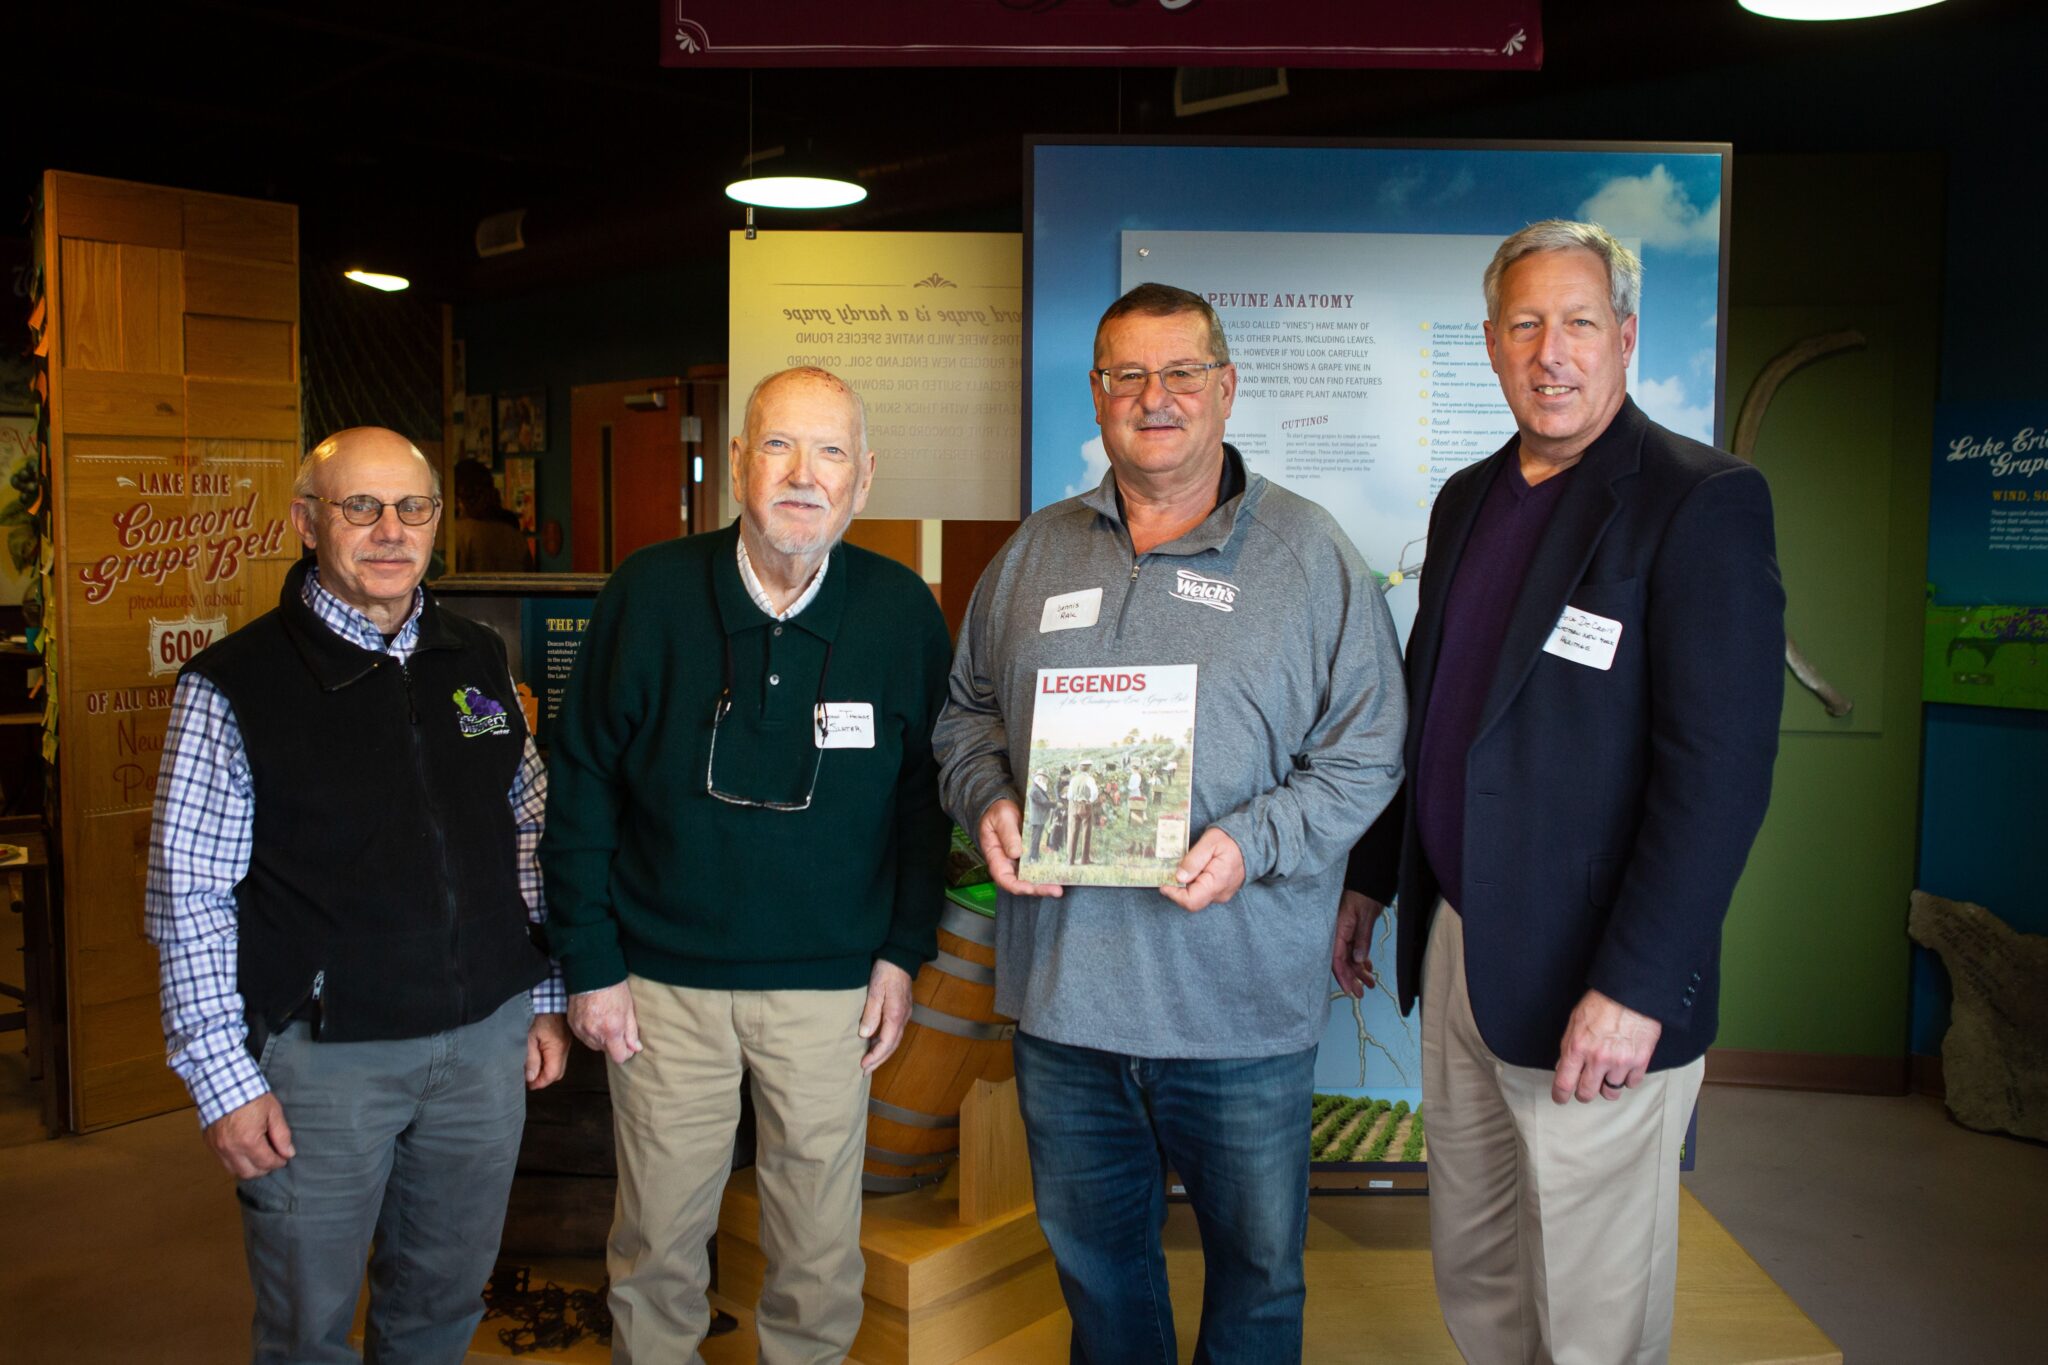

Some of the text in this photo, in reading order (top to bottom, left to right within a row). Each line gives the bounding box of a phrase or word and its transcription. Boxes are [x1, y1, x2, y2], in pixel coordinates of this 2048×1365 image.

[1273, 293, 1354, 309] ANATOMY
[1252, 320, 1281, 330] CALLED
[1316, 320, 1334, 330] HAVE
[1337, 320, 1357, 330] MANY
[1360, 320, 1370, 330] OF
[1235, 334, 1245, 344] AS
[1246, 334, 1270, 344] OTHER
[1305, 334, 1345, 344] INCLUDING
[1244, 348, 1280, 358] HOWEVER
[1281, 348, 1288, 358] IF
[1290, 348, 1304, 358] YOU
[1306, 348, 1326, 358] LOOK
[1328, 348, 1369, 358] CAREFULLY
[1256, 362, 1280, 372] WHICH
[1282, 362, 1309, 372] SHOWS
[1310, 362, 1316, 372] A
[1318, 362, 1343, 372] GRAPE
[1344, 362, 1361, 372] VINE
[1363, 362, 1371, 372] IN
[1243, 376, 1259, 386] AND
[1292, 376, 1307, 386] YOU
[1309, 376, 1325, 386] CAN
[1327, 376, 1344, 386] FIND
[1345, 376, 1383, 386] FEATURES
[1238, 390, 1266, 400] UNIQUE
[1268, 390, 1278, 400] TO
[1279, 390, 1304, 400] GRAPE
[1306, 390, 1330, 400] PLANT
[1281, 415, 1329, 430] CUTTINGS
[1947, 435, 2005, 461] Lake
[139, 472, 232, 497] LAKE ERIE
[113, 493, 260, 550] Concord
[79, 519, 288, 604] Grape Belt
[1177, 577, 1236, 604] Welch's
[128, 589, 245, 619] produces about
[546, 618, 575, 633] THE
[1042, 673, 1147, 694] LEGENDS
[87, 692, 111, 715] OF
[113, 689, 143, 712] ALL
